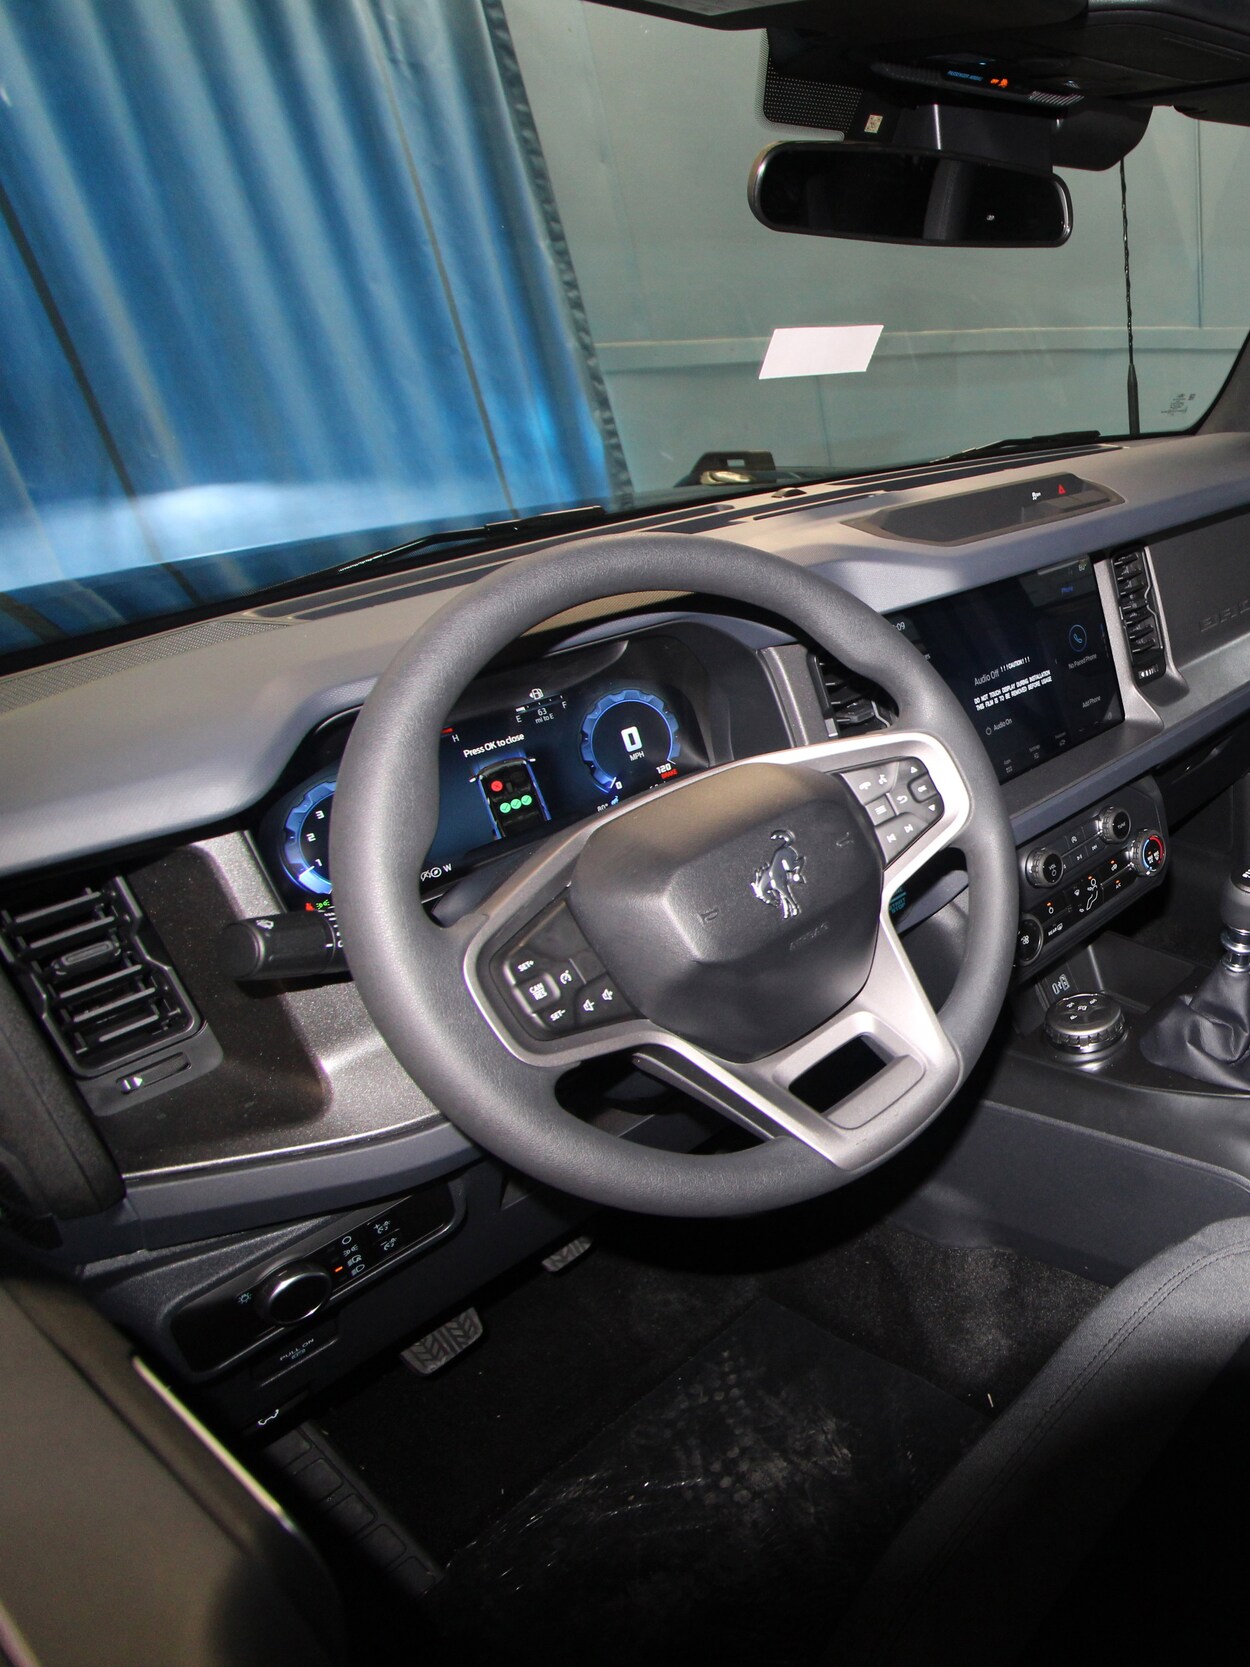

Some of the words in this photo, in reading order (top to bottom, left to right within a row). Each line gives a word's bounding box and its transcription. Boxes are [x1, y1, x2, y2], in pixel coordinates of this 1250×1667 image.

[1085, 653, 1097, 662] Phone
[974, 674, 991, 686] Audio
[990, 668, 1000, 680] Off
[980, 694, 989, 702] NOT
[988, 689, 1002, 698] TOUCH
[1001, 683, 1016, 693] DISPLAY
[1015, 677, 1029, 688] DURING
[1029, 669, 1051, 682] INSTALLATION
[975, 703, 985, 711] THIS
[984, 699, 994, 708] FILM
[1005, 692, 1011, 700] BE
[1010, 686, 1028, 697] REMOVED
[1027, 680, 1041, 691] BEFORE
[1040, 675, 1053, 685] USAGE
[561, 700, 567, 709] F
[537, 707, 548, 716] 63
[542, 714, 550, 722] to
[549, 712, 555, 720] E
[515, 715, 522, 723] E
[993, 721, 1006, 731] Audio
[1005, 718, 1013, 726] On
[452, 734, 460, 743] H
[621, 726, 642, 752] 0
[463, 745, 485, 758] Press
[484, 741, 497, 752] OK
[496, 738, 506, 748] to
[505, 733, 525, 745] close
[629, 750, 645, 762] MPH
[656, 763, 671, 774] 120
[661, 769, 677, 779] BRAKE
[615, 781, 623, 790] 0
[315, 810, 325, 820] 3
[305, 832, 316, 843] 2
[315, 858, 323, 867] 1
[442, 863, 452, 873] W
[517, 960, 534, 972] SET+
[529, 982, 544, 993] CAN
[533, 990, 547, 1000] RES
[550, 1009, 566, 1021] SET-
[279, 1347, 299, 1361] PULL
[302, 1338, 314, 1348] ON
